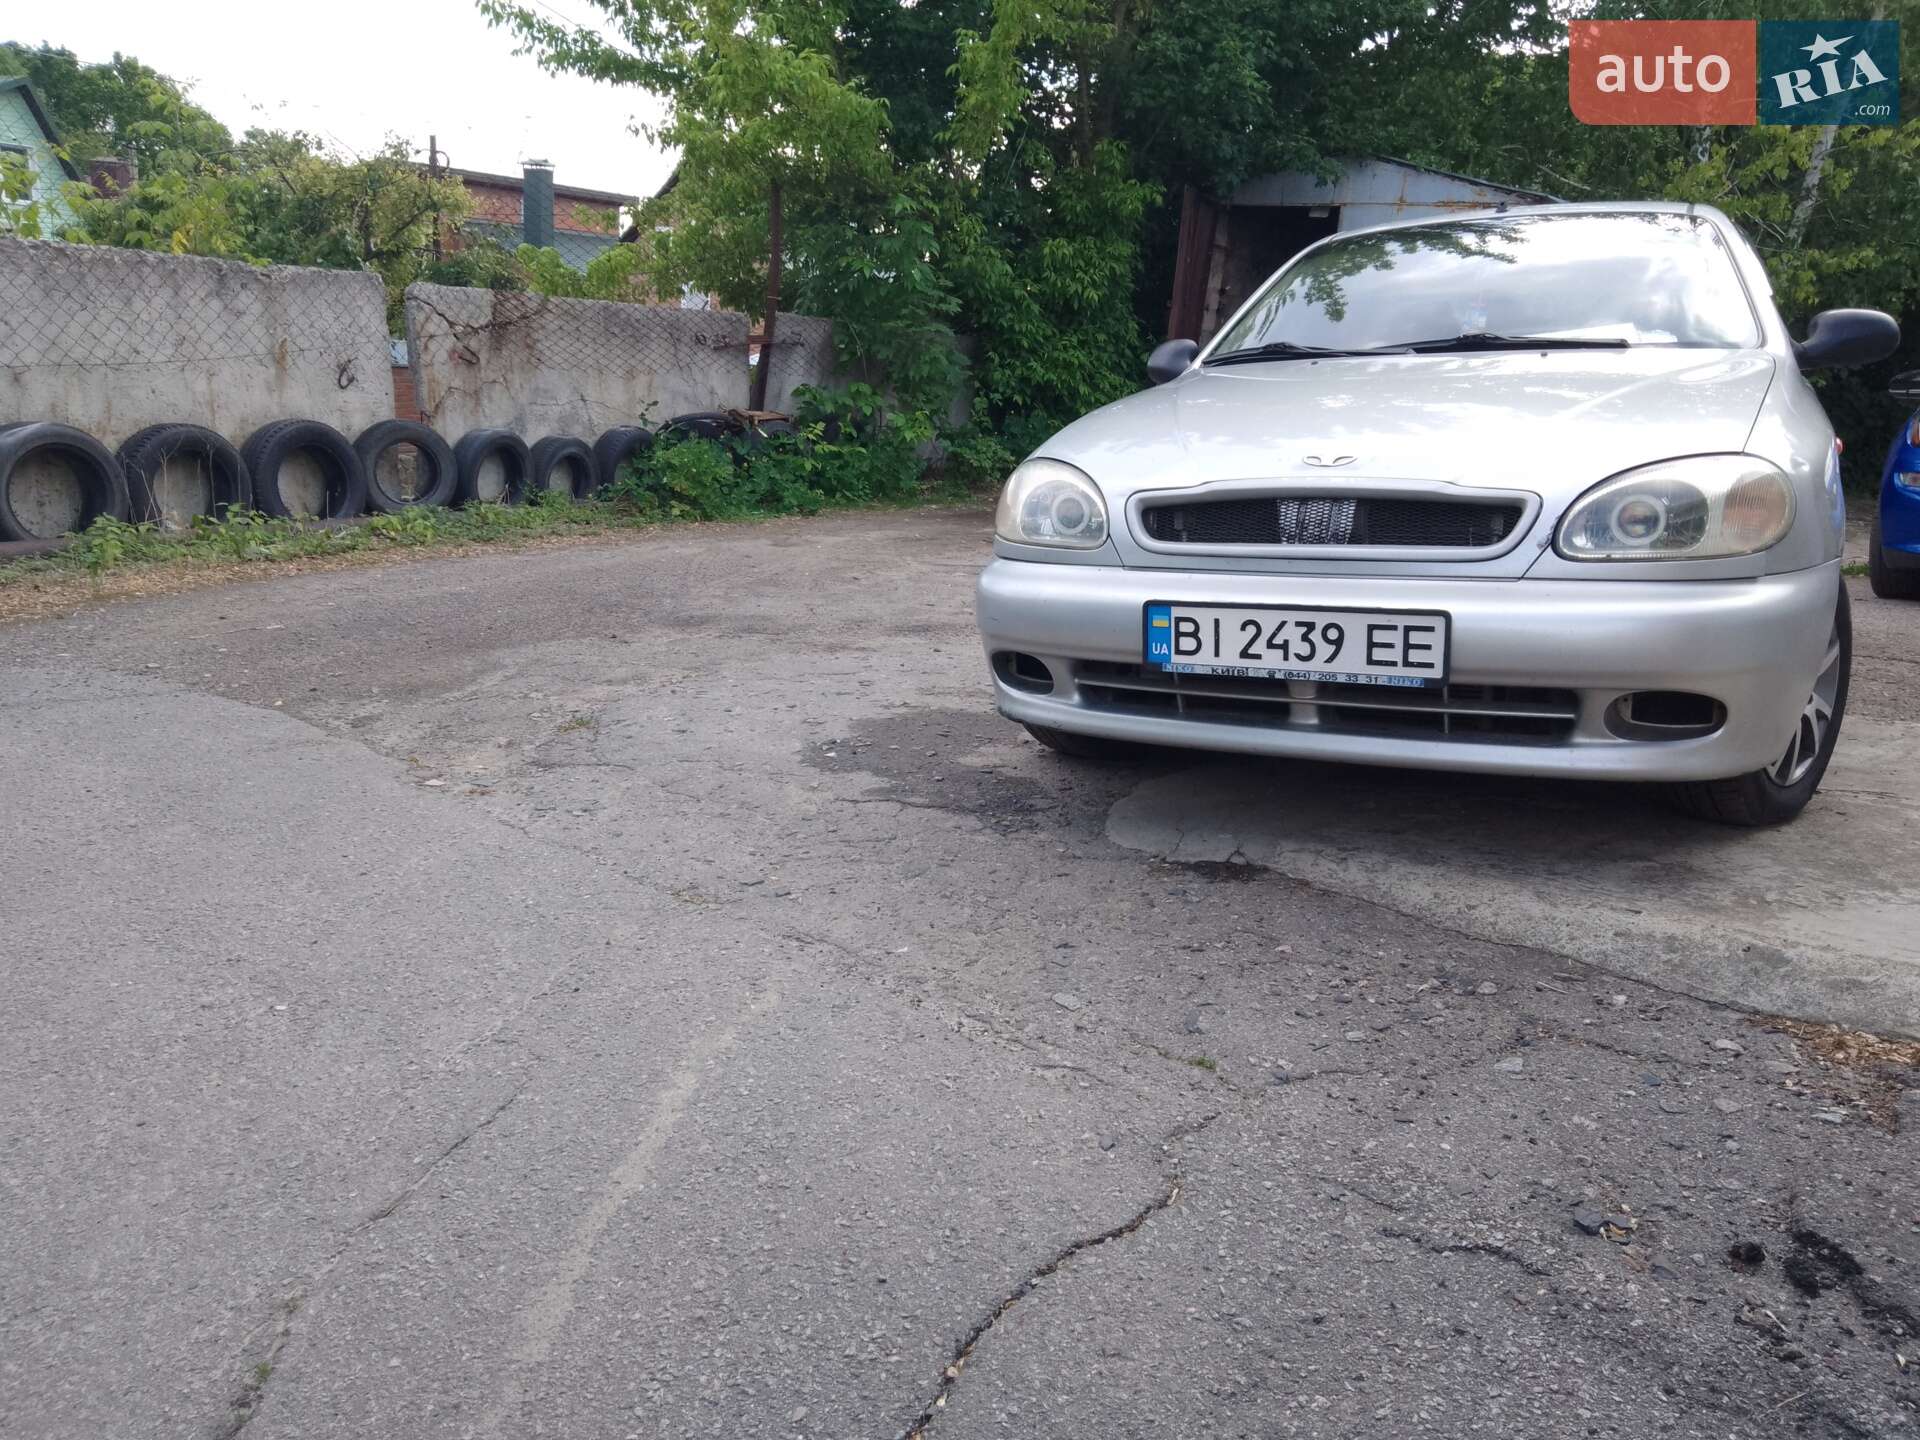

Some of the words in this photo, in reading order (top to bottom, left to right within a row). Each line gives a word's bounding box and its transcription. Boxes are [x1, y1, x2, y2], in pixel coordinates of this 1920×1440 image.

[1152, 642, 1169, 655] UA
[1174, 616, 1220, 658] BI
[1239, 619, 1345, 663] 2439
[1366, 623, 1436, 669] EE
[1284, 671, 1311, 680] (044)
[1318, 673, 1338, 681] 205
[1345, 675, 1359, 683] 33
[1365, 676, 1379, 684] 31
